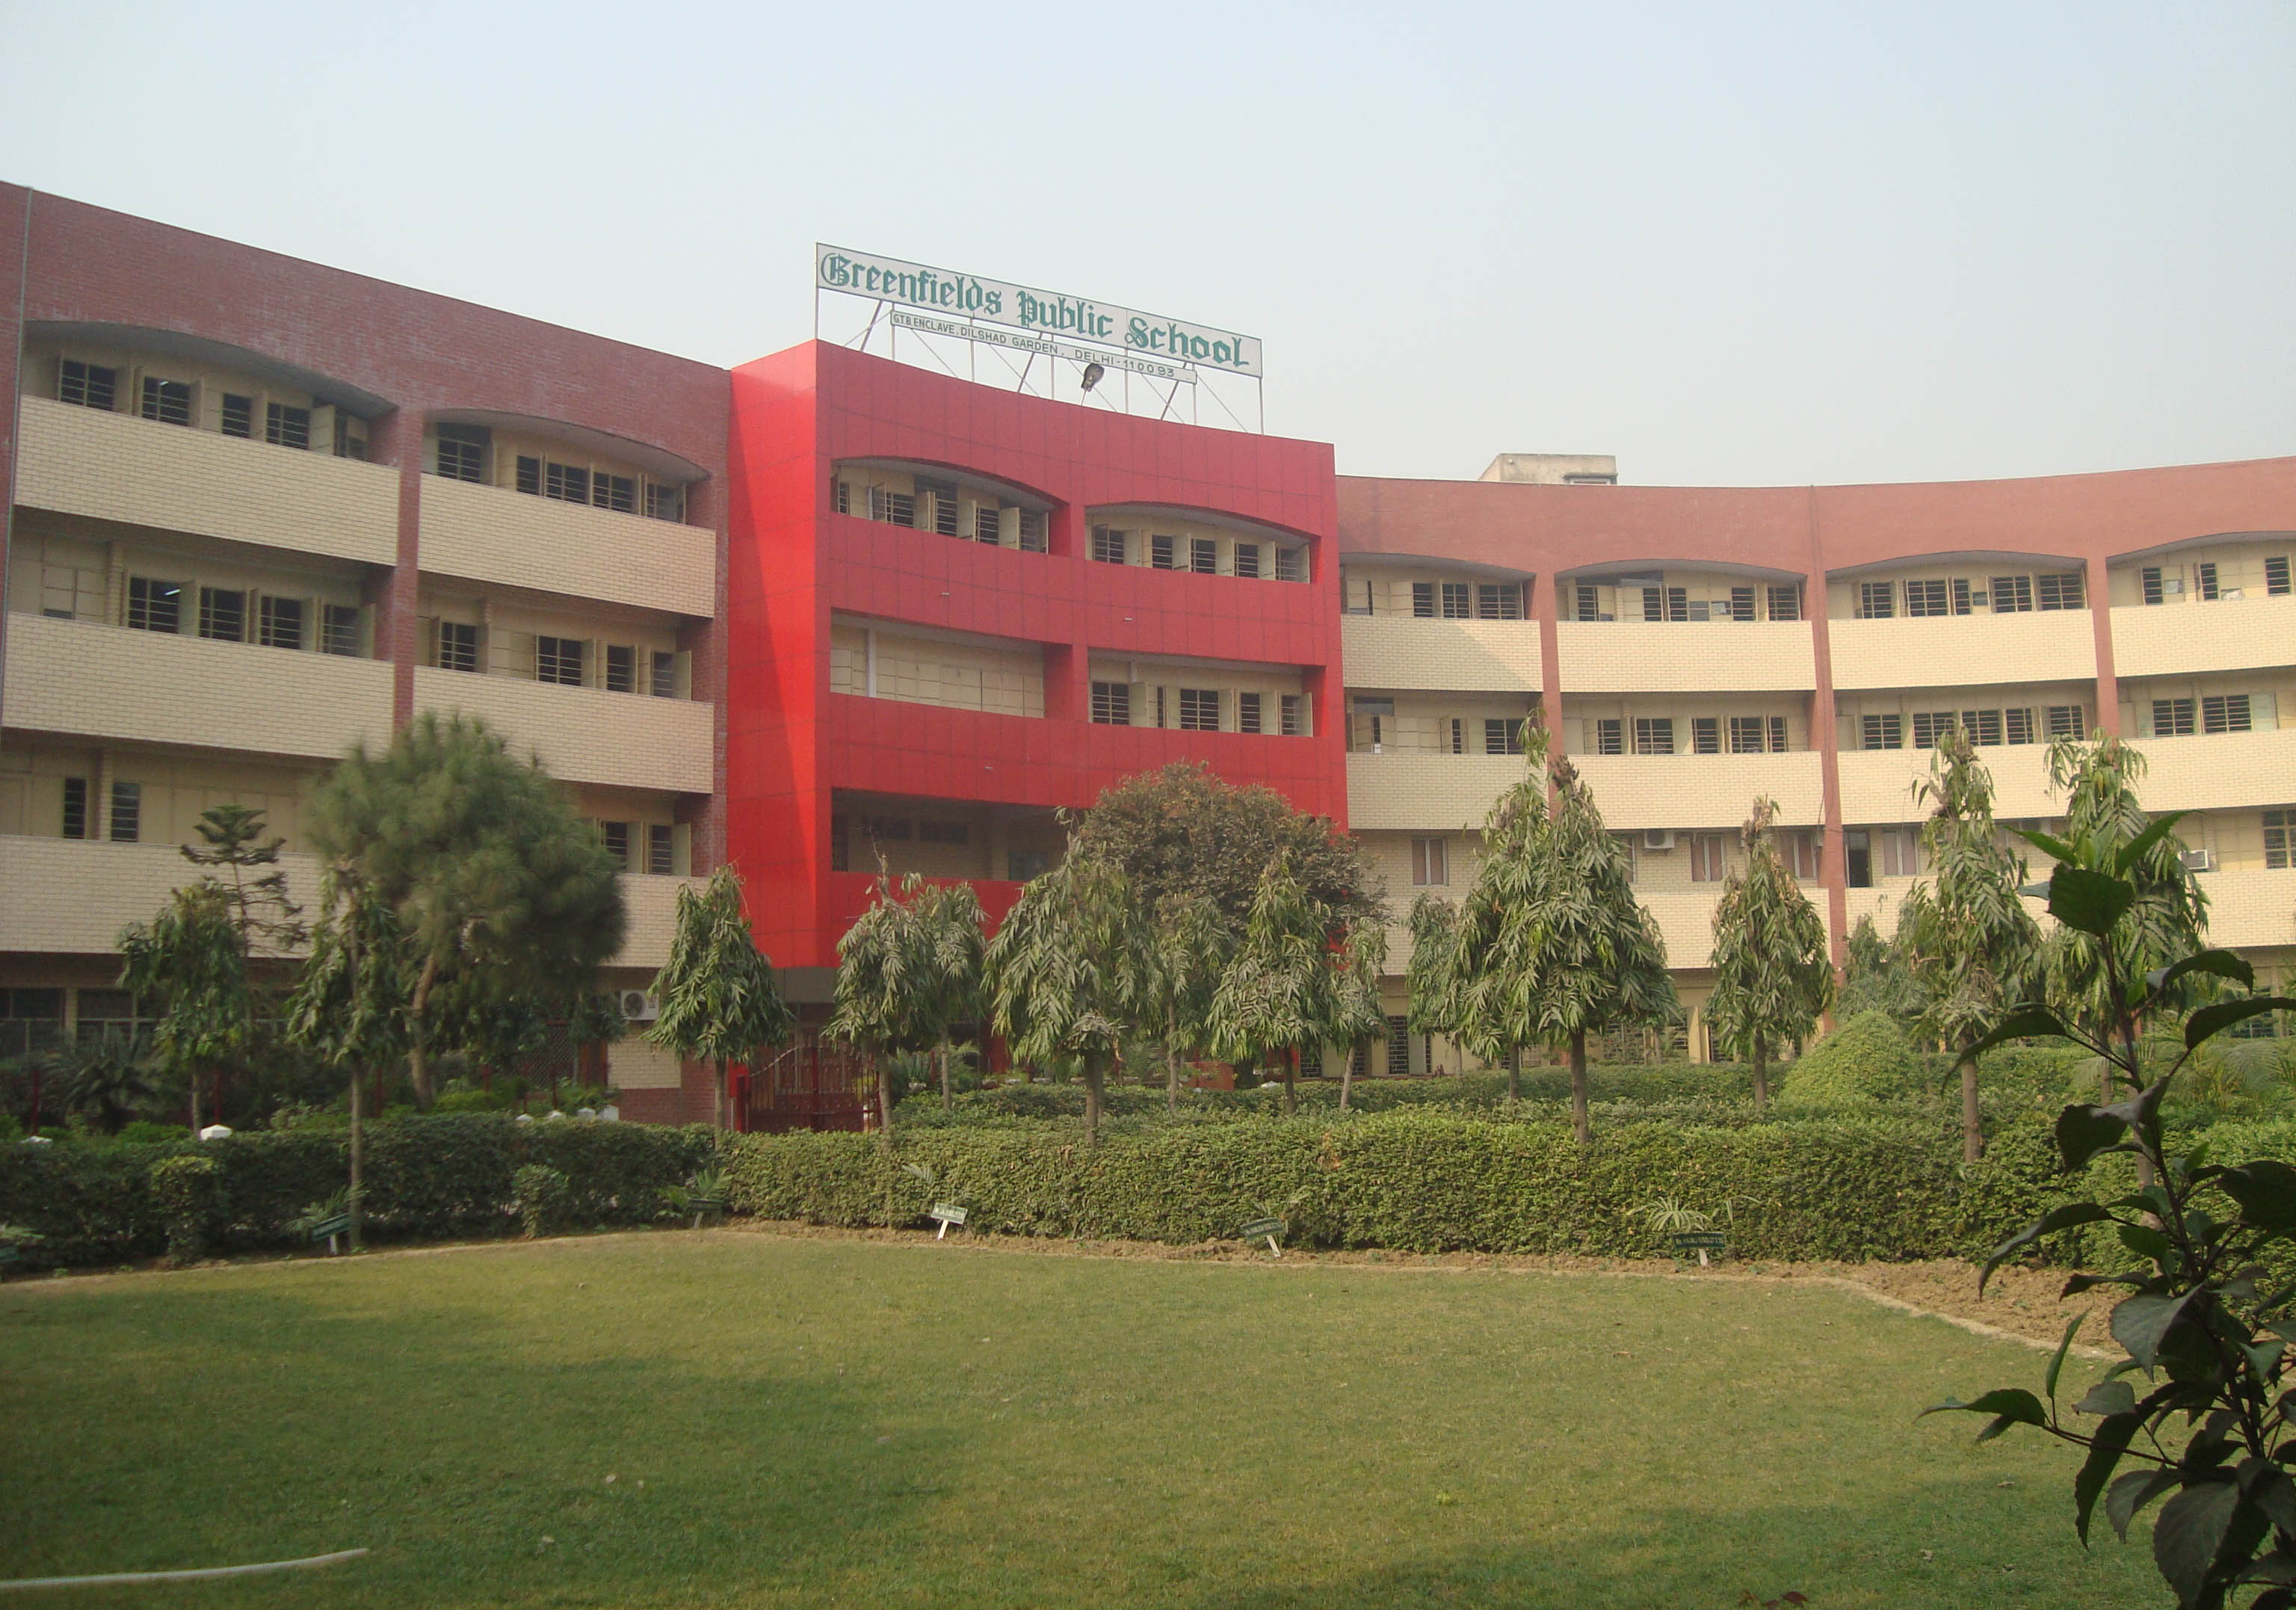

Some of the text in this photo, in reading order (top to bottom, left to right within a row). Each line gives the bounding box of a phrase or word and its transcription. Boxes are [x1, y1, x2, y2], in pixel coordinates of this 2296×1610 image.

[821, 253, 1250, 368] Greenfields Public School
[960, 327, 1007, 344] DILSHAD
